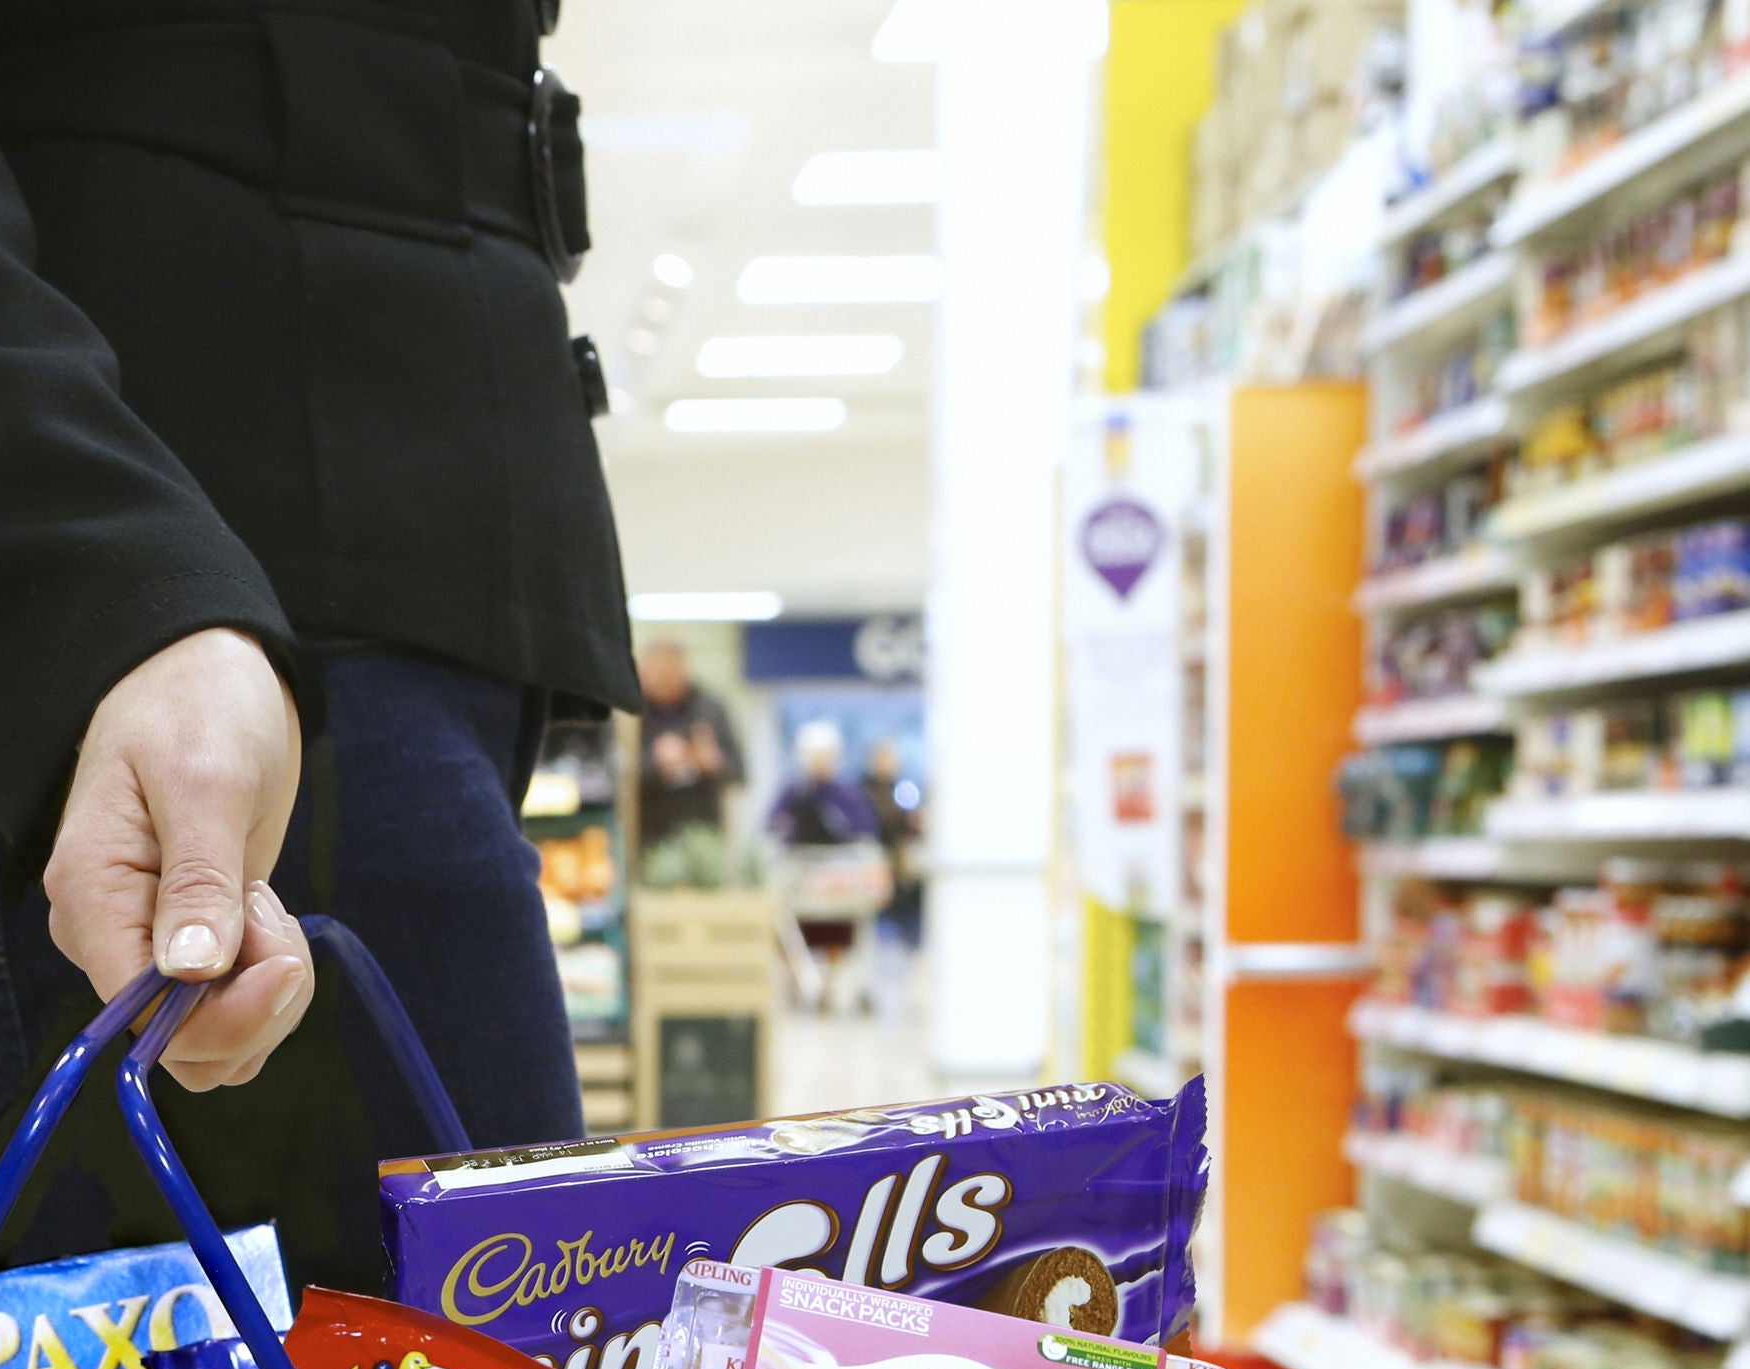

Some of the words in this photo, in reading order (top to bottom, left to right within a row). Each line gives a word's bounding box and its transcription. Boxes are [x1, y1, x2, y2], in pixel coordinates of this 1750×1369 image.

[440, 1230, 676, 1326] Cadbury
[782, 1278, 870, 1303] INDIVIDUALLY
[870, 1296, 934, 1317] WRAPPED
[779, 1288, 855, 1318] SNACK
[859, 1303, 930, 1333] PACKS
[1066, 1356, 1091, 1368] FREE
[1077, 1340, 1113, 1354] NATURAL
[1113, 1347, 1152, 1362] FLAVOURS
